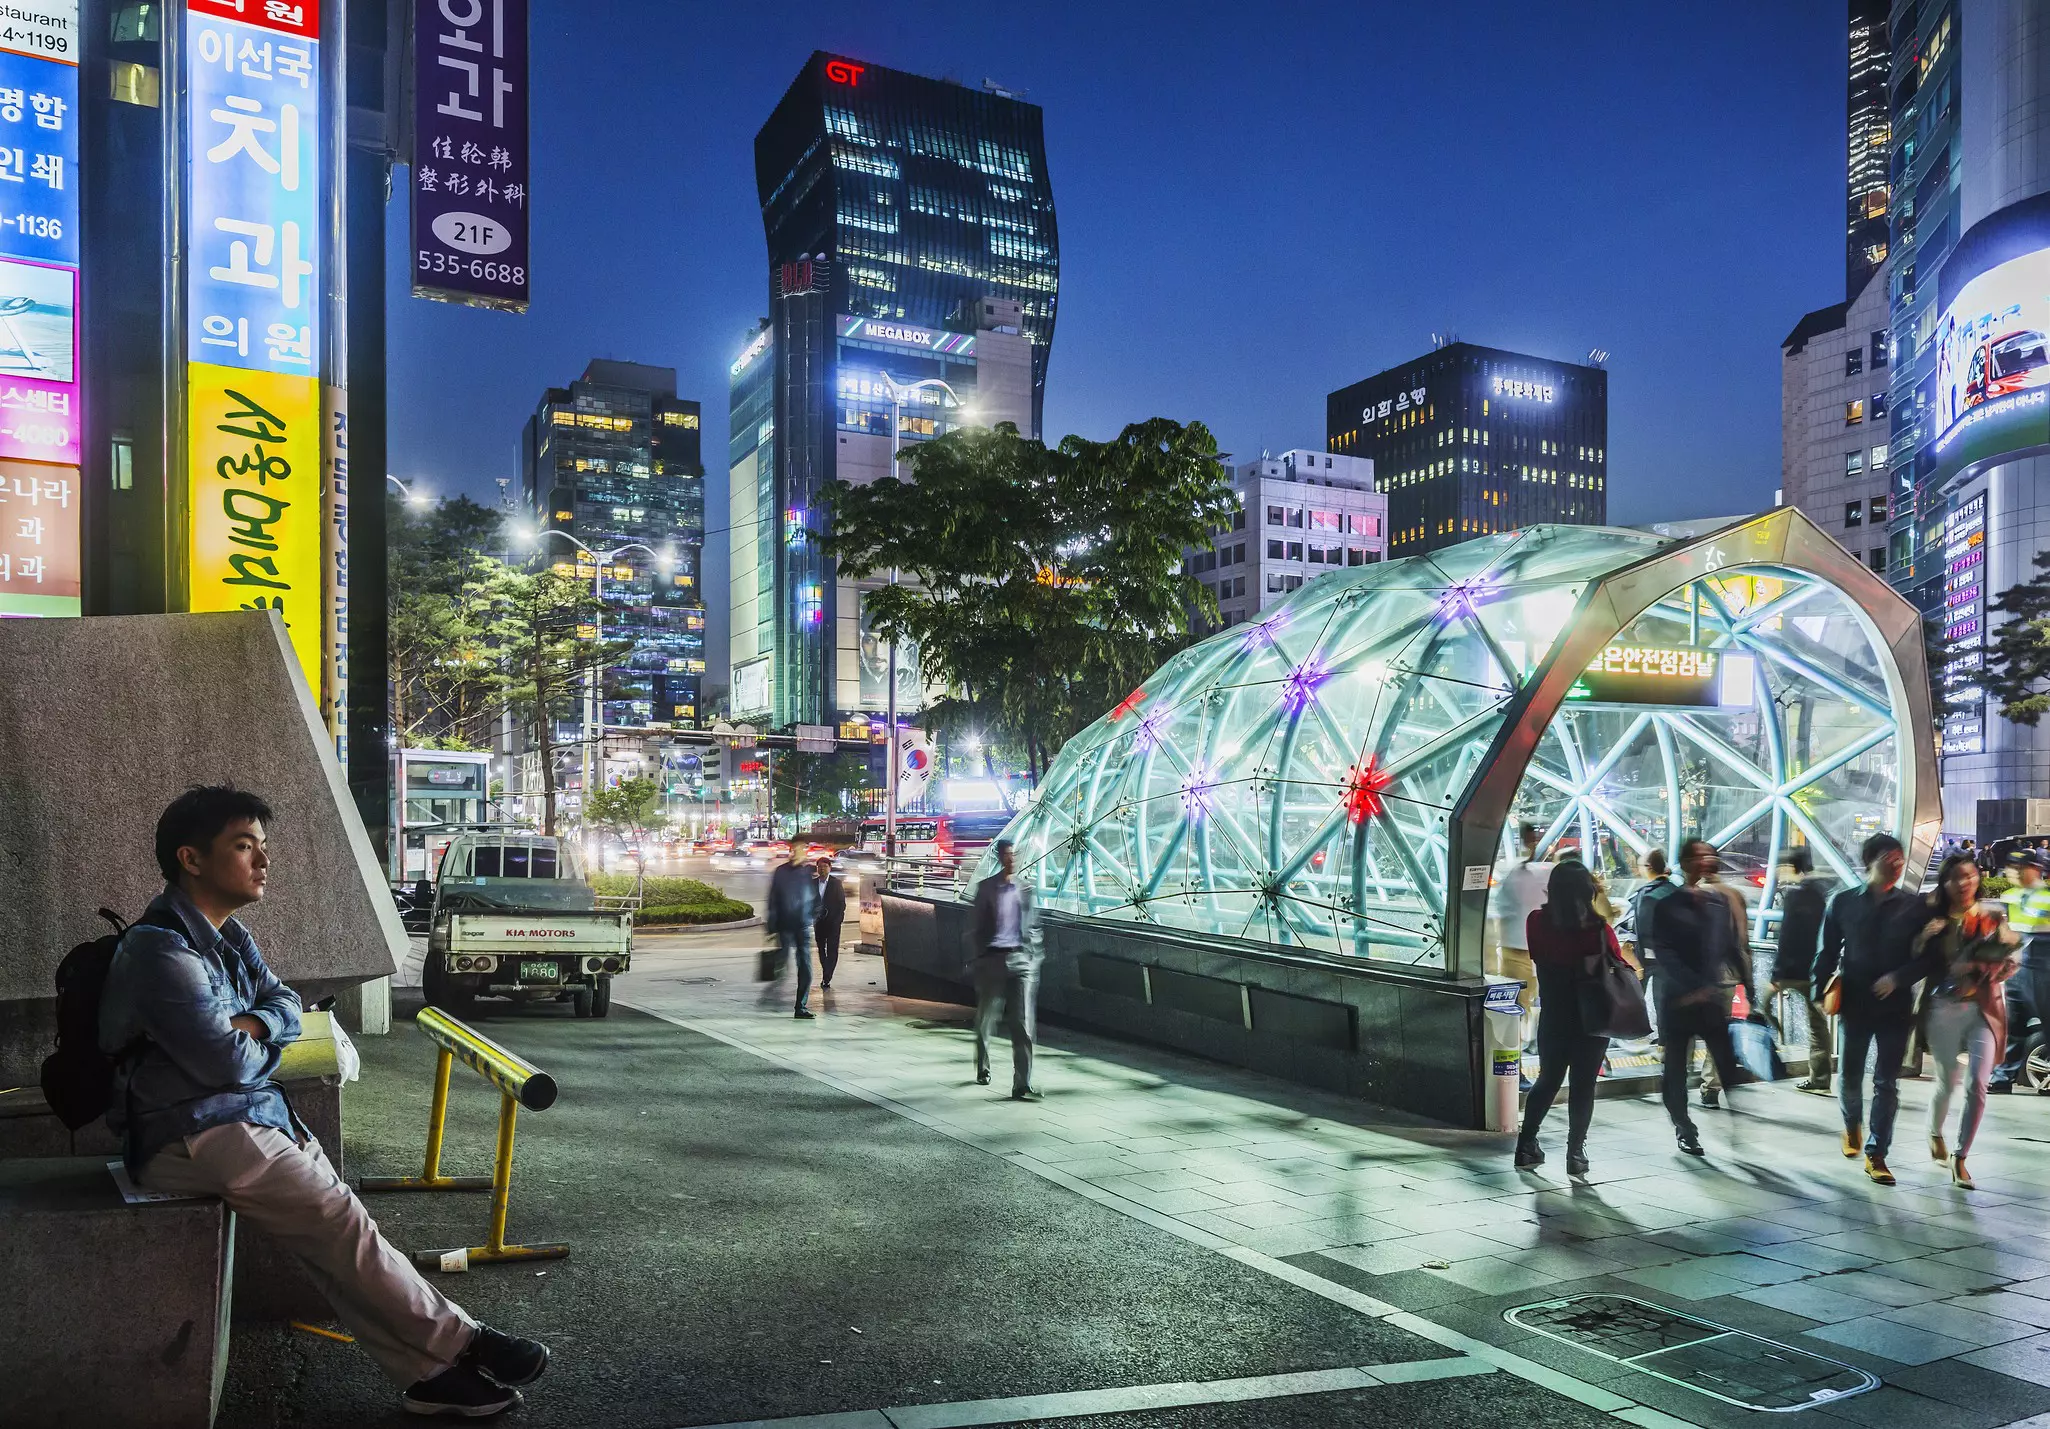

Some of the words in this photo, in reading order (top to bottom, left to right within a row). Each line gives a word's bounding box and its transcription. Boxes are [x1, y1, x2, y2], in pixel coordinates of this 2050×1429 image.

[0, 27, 68, 52] 4~1199
[198, 29, 313, 89] 이선국
[826, 60, 865, 87] GT
[432, 135, 513, 174] 佳轮韩
[418, 164, 526, 210] 整形外科
[0, 212, 62, 240] -1136
[454, 222, 494, 245] 21F
[418, 250, 525, 285] 535-6688
[201, 314, 312, 365] 의원
[865, 323, 931, 345] MEGABOX
[0, 387, 69, 416] 스센터
[505, 929, 526, 937] KIA
[529, 929, 576, 938] MOTORS
